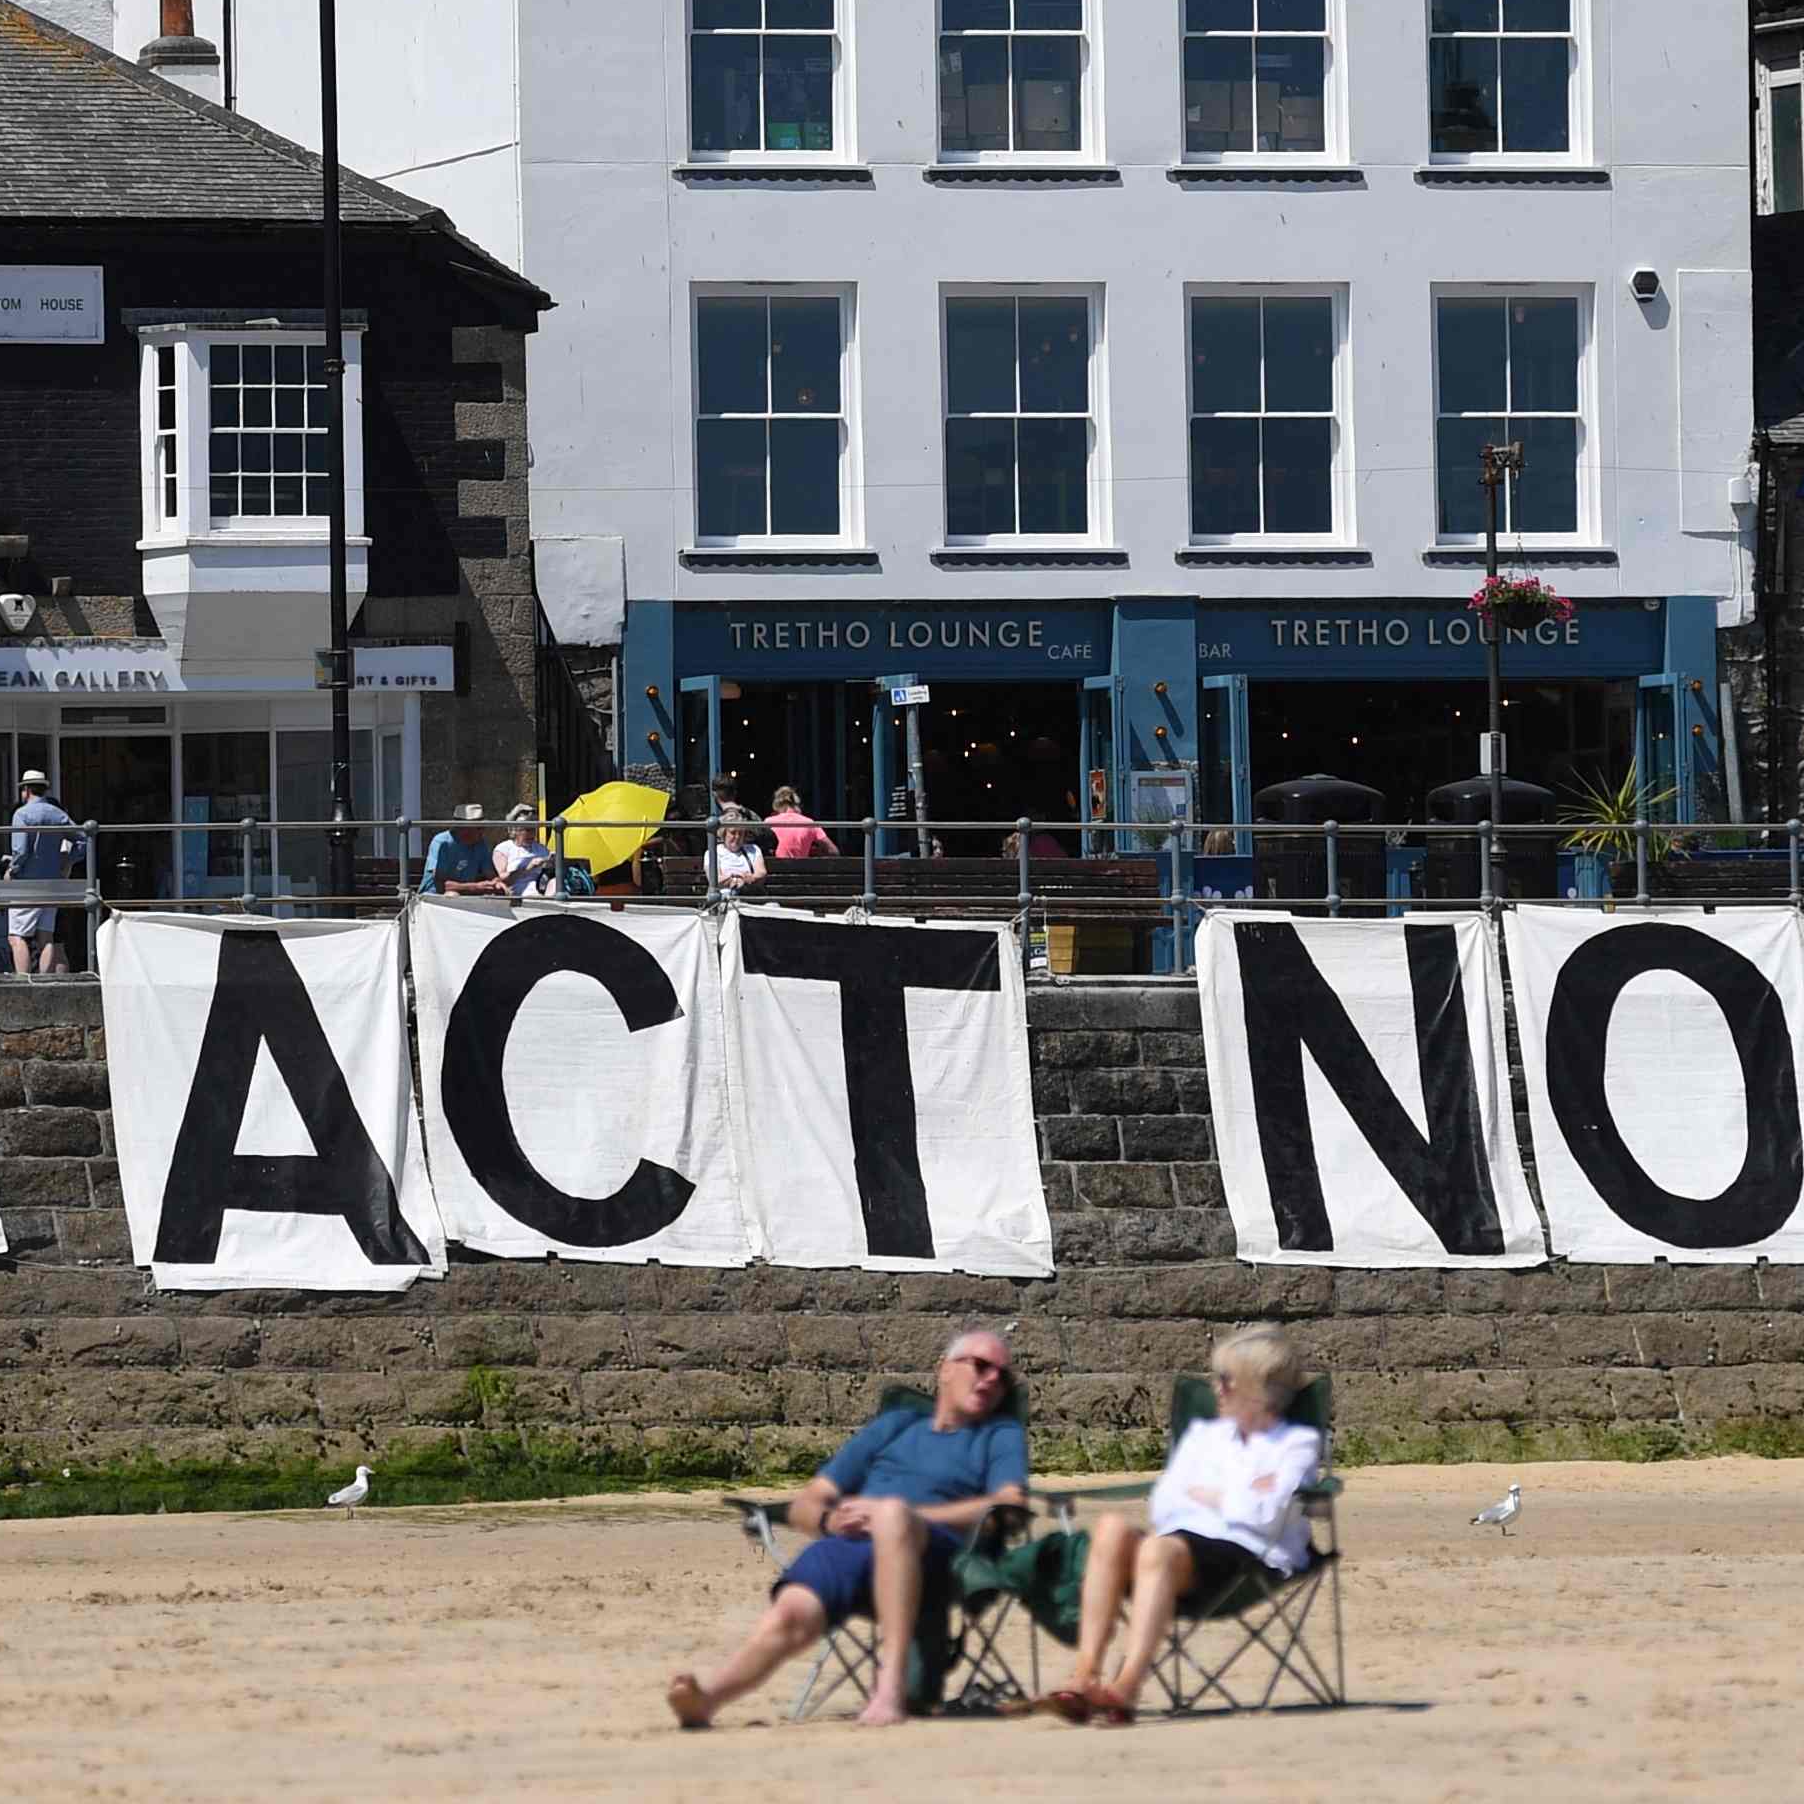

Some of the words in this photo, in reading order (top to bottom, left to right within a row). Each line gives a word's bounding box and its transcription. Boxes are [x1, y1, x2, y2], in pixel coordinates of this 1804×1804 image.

[40, 297, 85, 310] HOUSE
[729, 620, 872, 650] TRETHO
[889, 619, 1044, 649] LOUNGE
[1271, 618, 1411, 646] TRETHO
[1198, 642, 1232, 659] BAR
[54, 670, 166, 688] GALLERY
[356, 675, 374, 686] RT
[380, 676, 389, 686] &
[395, 675, 438, 686] GIFTS
[153, 914, 1002, 1265] ACT
